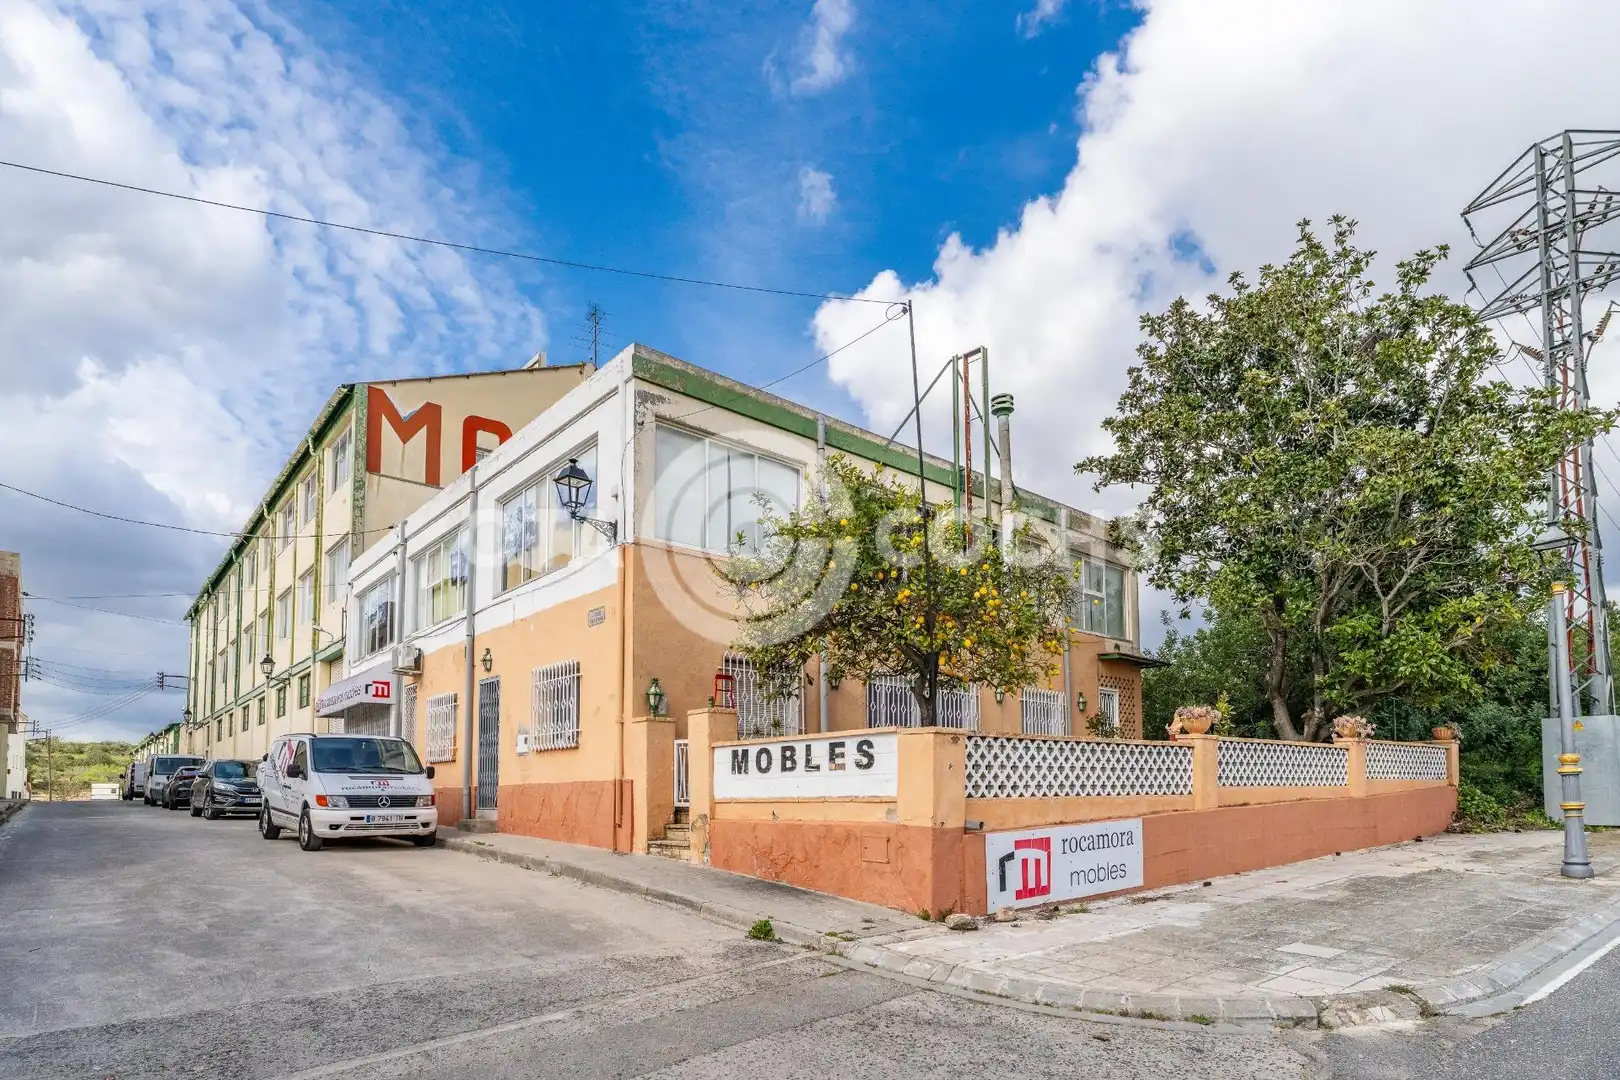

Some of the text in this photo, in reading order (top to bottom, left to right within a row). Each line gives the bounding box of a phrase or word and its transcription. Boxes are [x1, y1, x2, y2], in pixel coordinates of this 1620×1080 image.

[731, 739, 875, 775] MOBLES
[1061, 829, 1134, 855] rocamora
[1070, 862, 1127, 887] mobles
